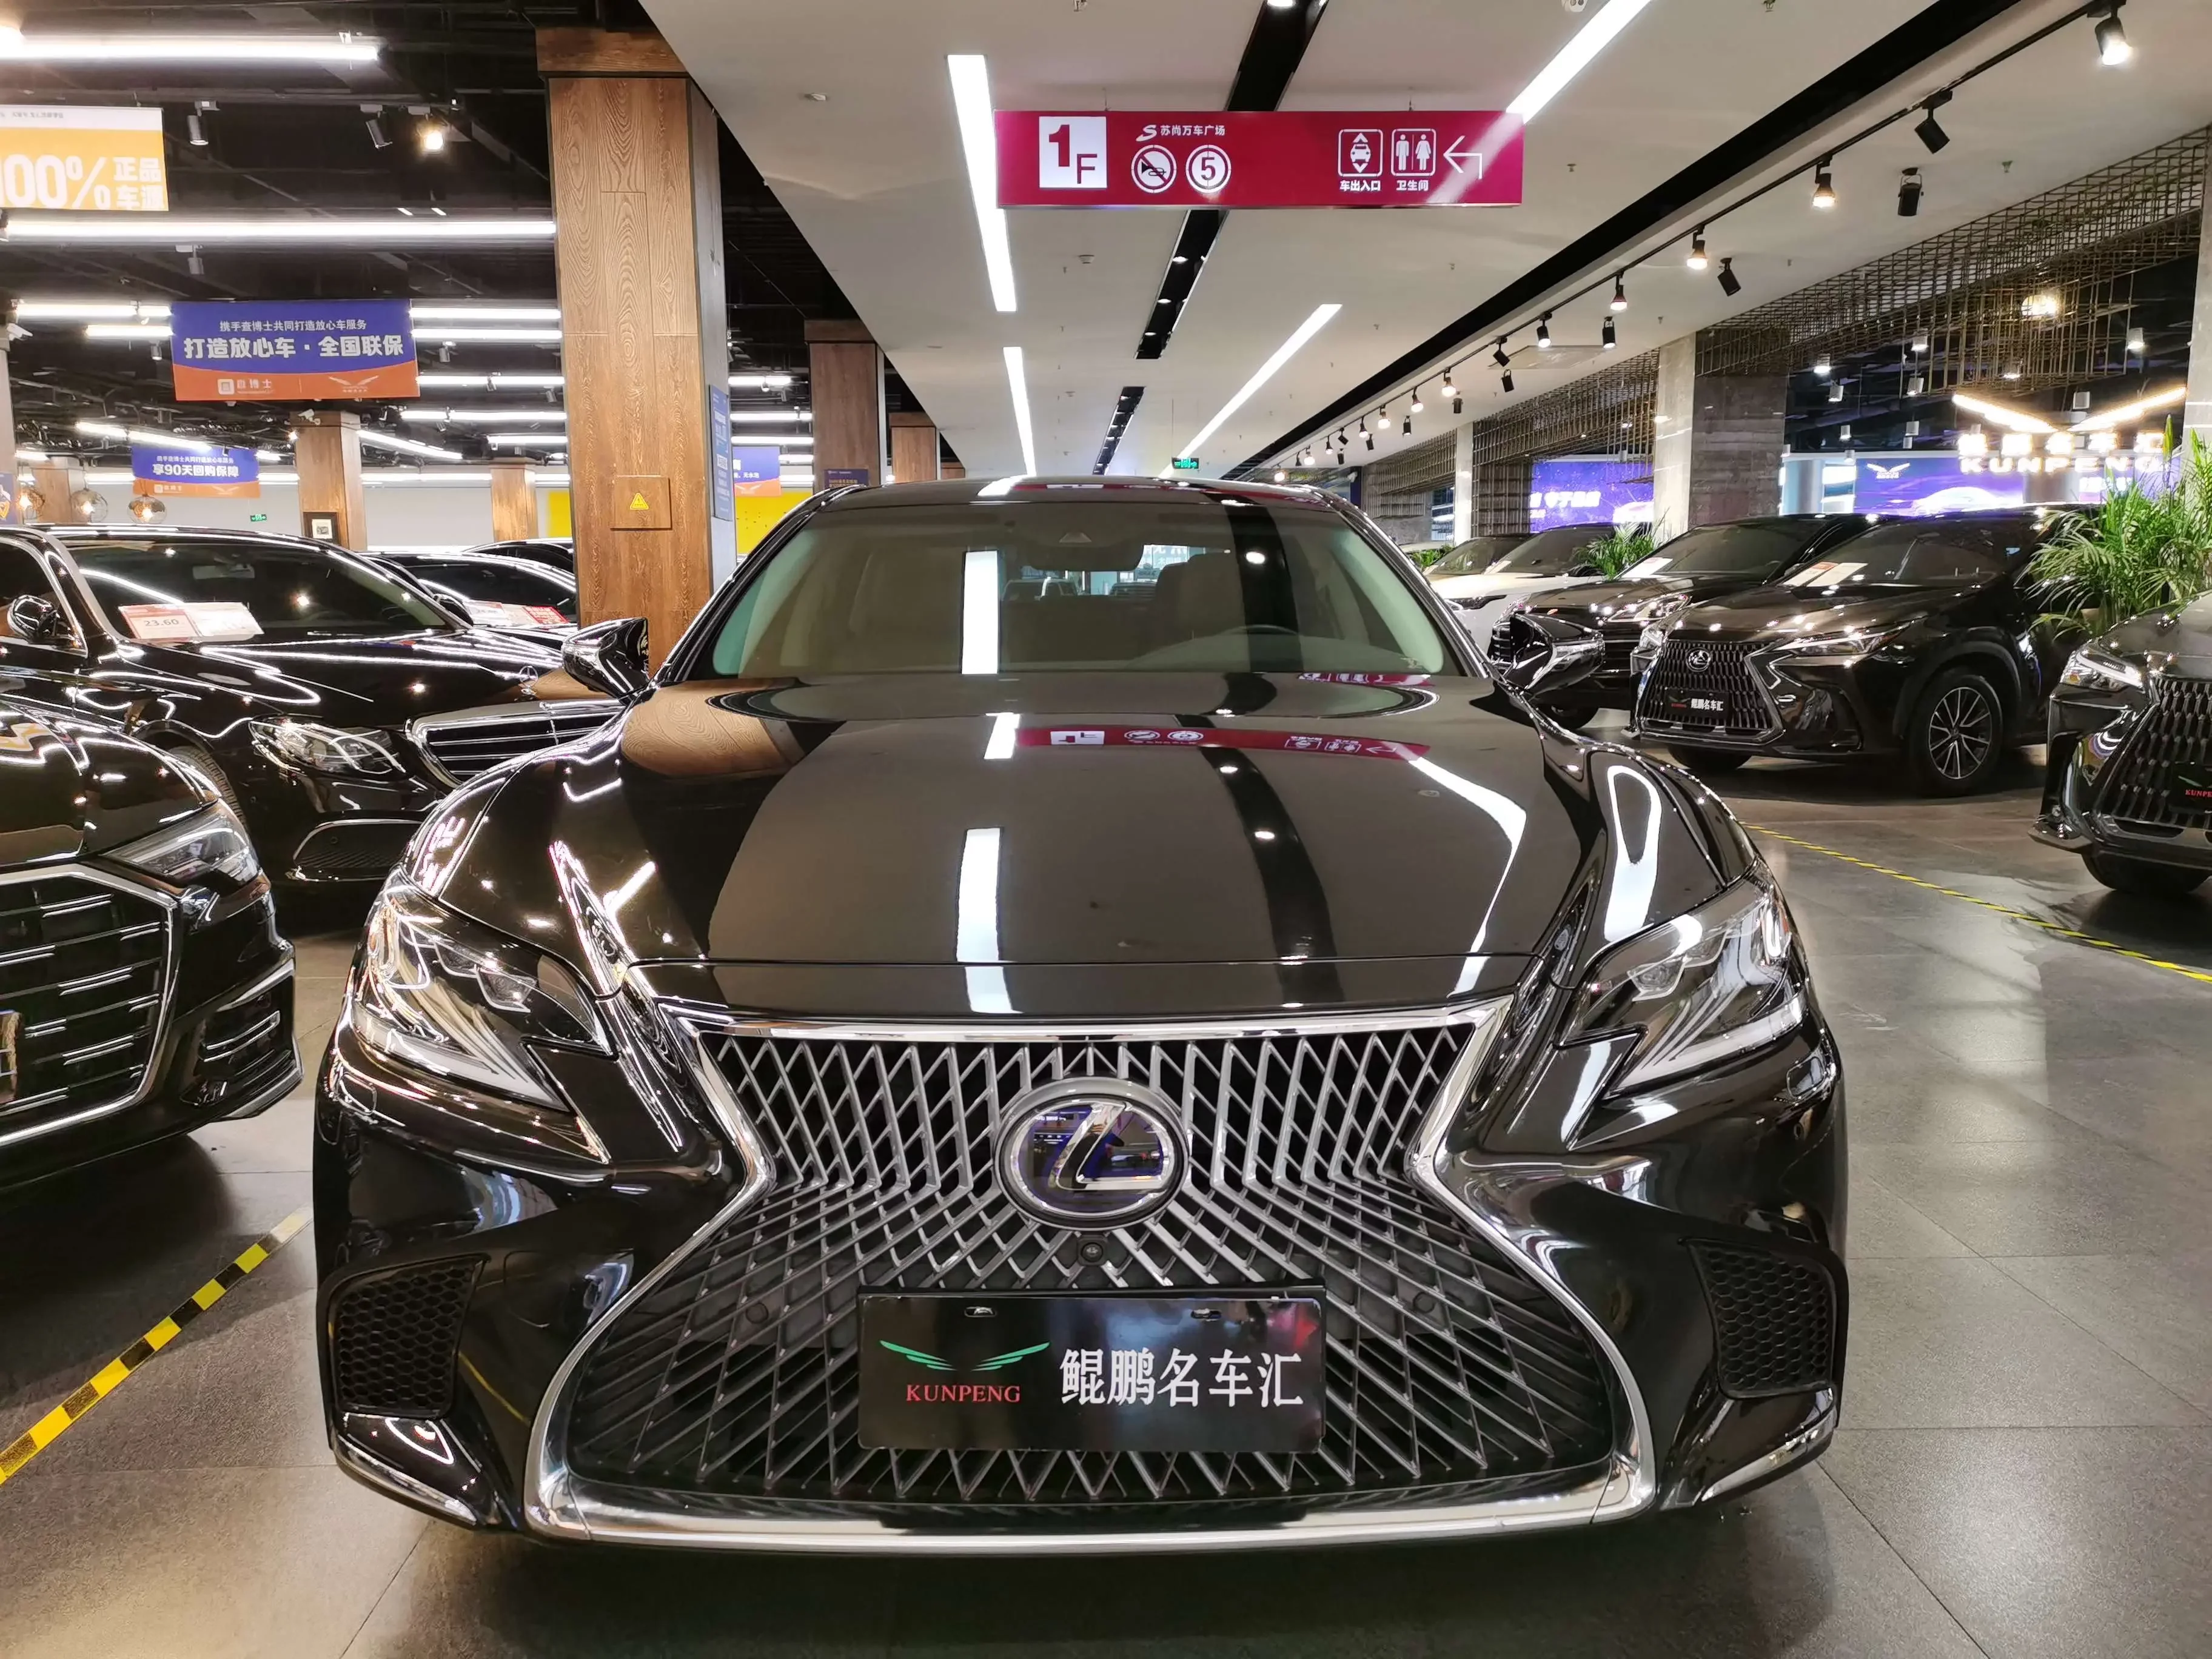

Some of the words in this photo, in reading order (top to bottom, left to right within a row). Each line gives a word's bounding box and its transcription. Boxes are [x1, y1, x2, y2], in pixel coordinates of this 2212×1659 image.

[1160, 125, 1225, 136] 苏尚万车广场
[113, 156, 162, 183] 正品
[1201, 156, 1216, 181] 5
[0, 154, 111, 210] 00%
[1339, 179, 1381, 192] 车出入口
[1396, 179, 1429, 192] 卫生间
[116, 184, 165, 210] 车源
[219, 319, 367, 332] 携手查博士共同打造放心车服务
[152, 463, 240, 478] 享90天回购保障
[144, 618, 179, 628] 23.60
[1059, 1347, 1304, 1407] 鲲鹏名车汇
[906, 1384, 1021, 1403] KUNPENG
